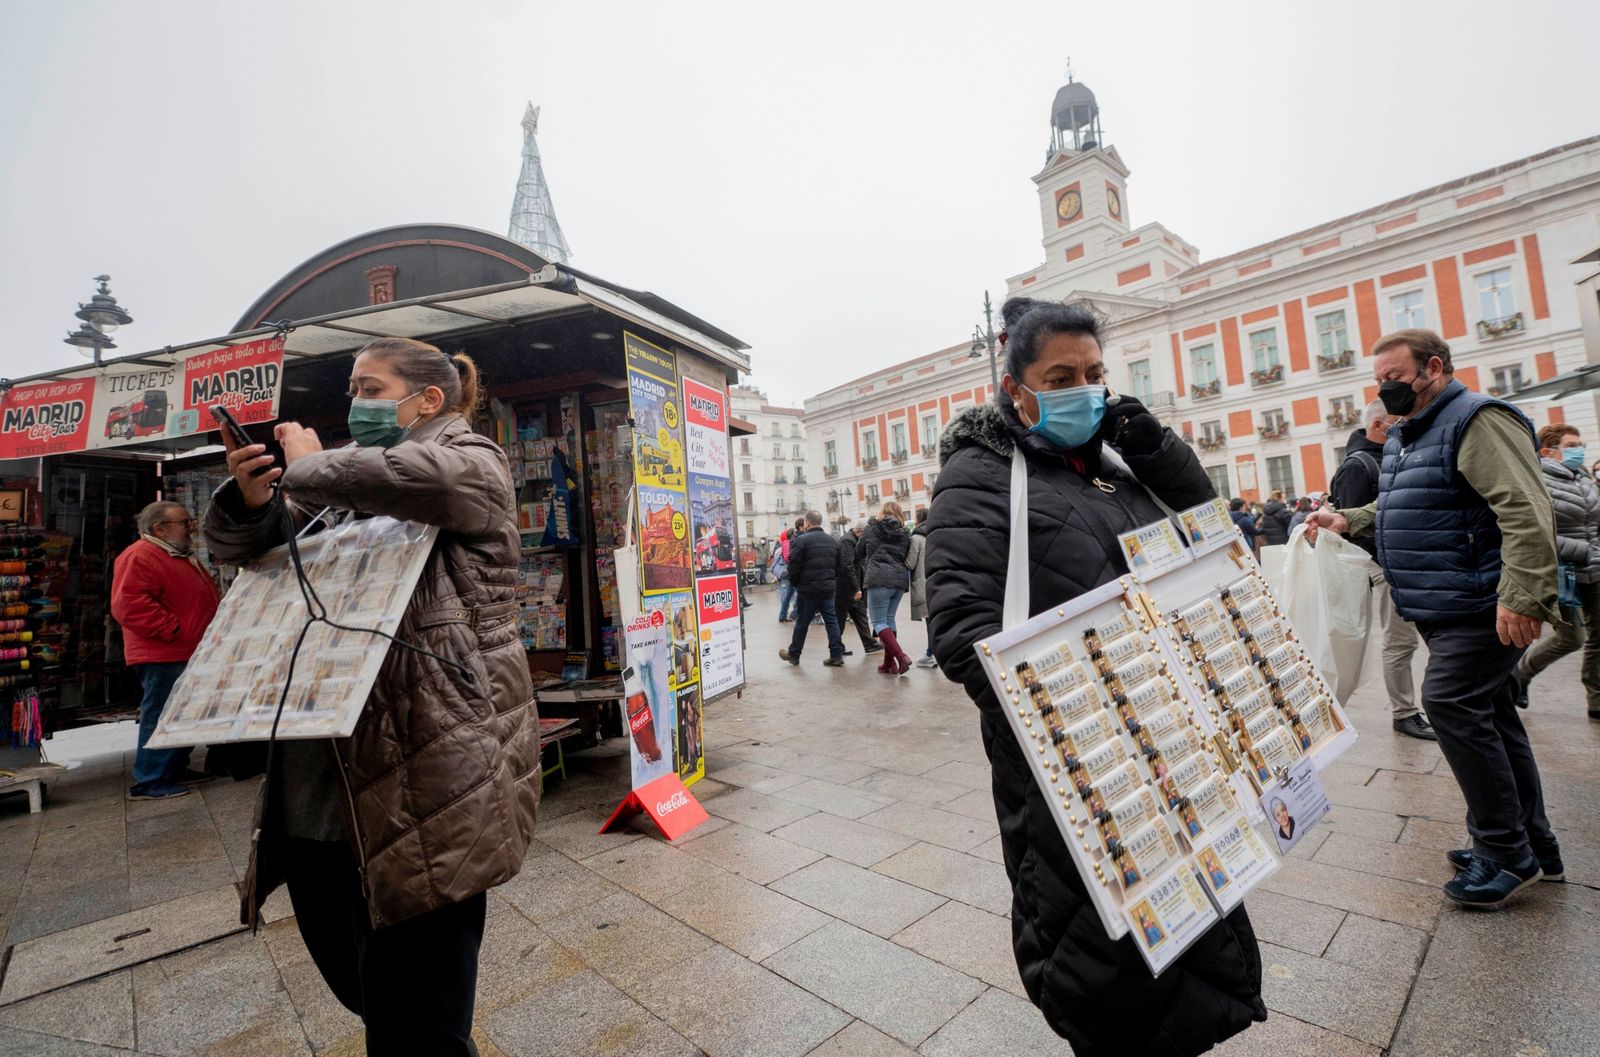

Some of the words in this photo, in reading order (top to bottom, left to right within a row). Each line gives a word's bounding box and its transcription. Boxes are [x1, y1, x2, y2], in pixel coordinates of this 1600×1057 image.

[187, 357, 206, 371] Sube
[214, 352, 233, 365] baja
[235, 345, 254, 359] todo
[257, 341, 265, 353] el
[628, 344, 639, 355] THE
[639, 349, 658, 364] YELLOW
[109, 368, 176, 393] TICKETS
[191, 362, 280, 406] MADRID
[630, 375, 666, 398] MADRID
[13, 389, 34, 401] HOP
[35, 388, 48, 400] ON
[48, 385, 66, 398] HOP
[67, 382, 84, 395] OFF
[219, 391, 246, 411] City
[243, 386, 275, 405] Tour
[632, 387, 643, 397] CITY
[644, 391, 658, 402] TOUR
[689, 393, 719, 416] MADRID
[2, 399, 85, 434] MADRID
[29, 423, 51, 442] City
[50, 421, 78, 438] Tour
[690, 427, 703, 439] Best
[691, 442, 704, 456] City
[691, 456, 706, 469] Tour
[639, 491, 674, 505] TOLEDO
[703, 589, 733, 609] MADRID
[627, 621, 651, 632] DRINKS
[635, 615, 651, 624] COLD
[631, 641, 643, 650] TAKE
[644, 639, 658, 648] AWAY
[1214, 827, 1240, 853] 96069
[1150, 876, 1180, 906] 53815
